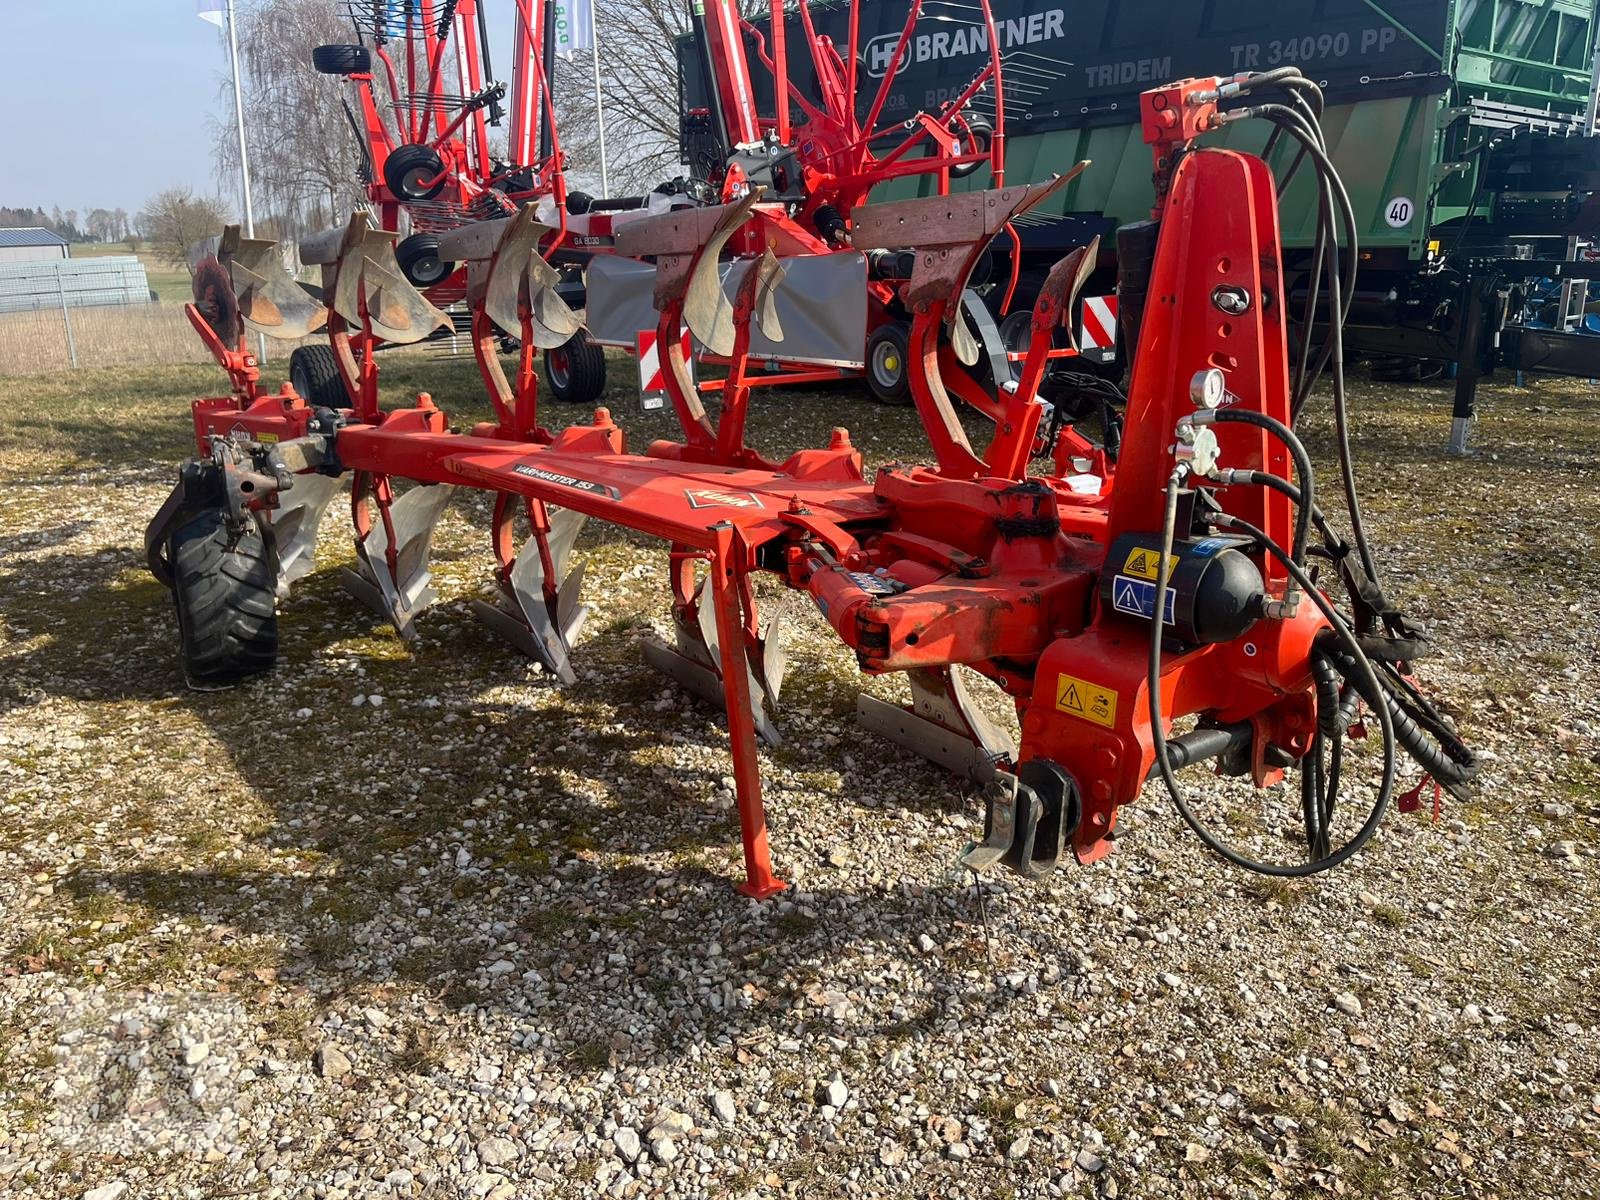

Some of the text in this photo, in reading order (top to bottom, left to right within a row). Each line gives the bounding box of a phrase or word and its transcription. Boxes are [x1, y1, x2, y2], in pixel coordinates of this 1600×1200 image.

[1230, 27, 1397, 68] TR 34090 PP
[1084, 56, 1171, 88] TRIDEM
[1390, 203, 1408, 221] 40
[574, 236, 600, 245] GA 8030
[575, 481, 595, 490] 153
